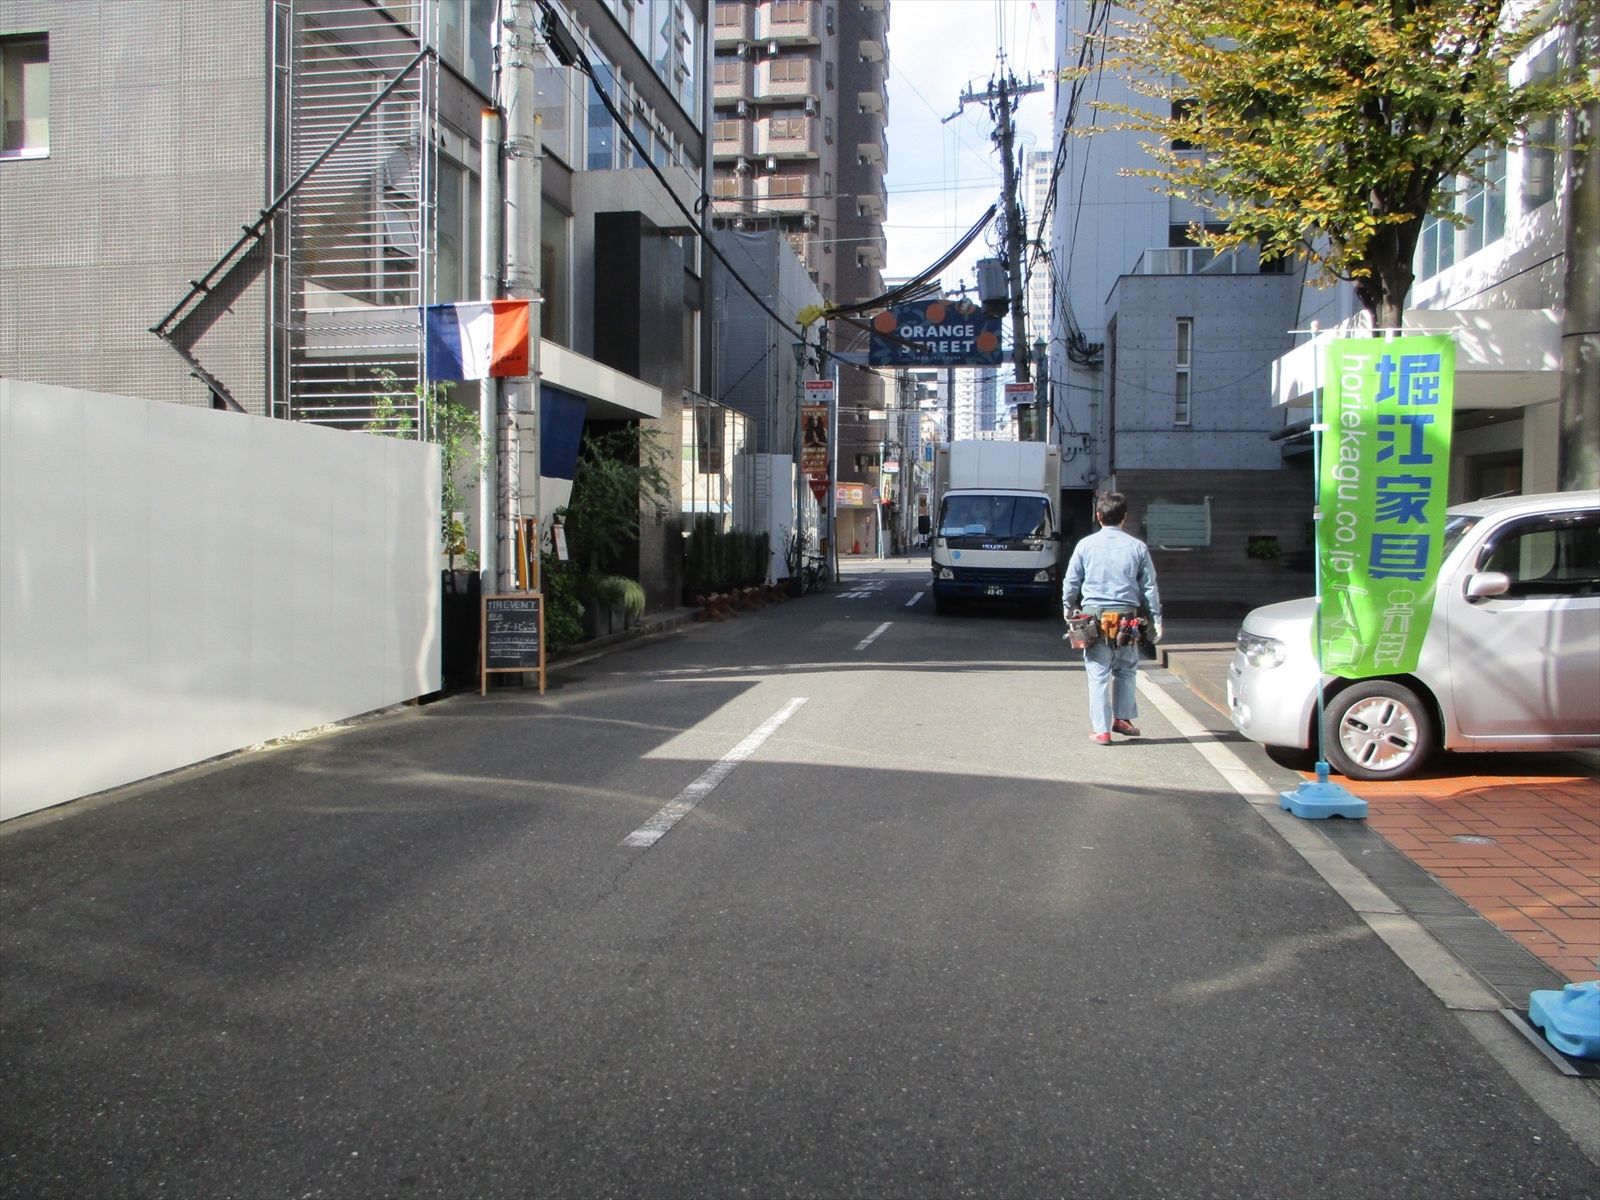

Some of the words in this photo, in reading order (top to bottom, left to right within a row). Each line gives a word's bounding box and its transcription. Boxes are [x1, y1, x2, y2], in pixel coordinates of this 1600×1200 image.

[900, 325, 975, 338] ORANGE
[1331, 355, 1368, 573] horiekagu.co.jp
[1368, 354, 1441, 581] 堀江家具
